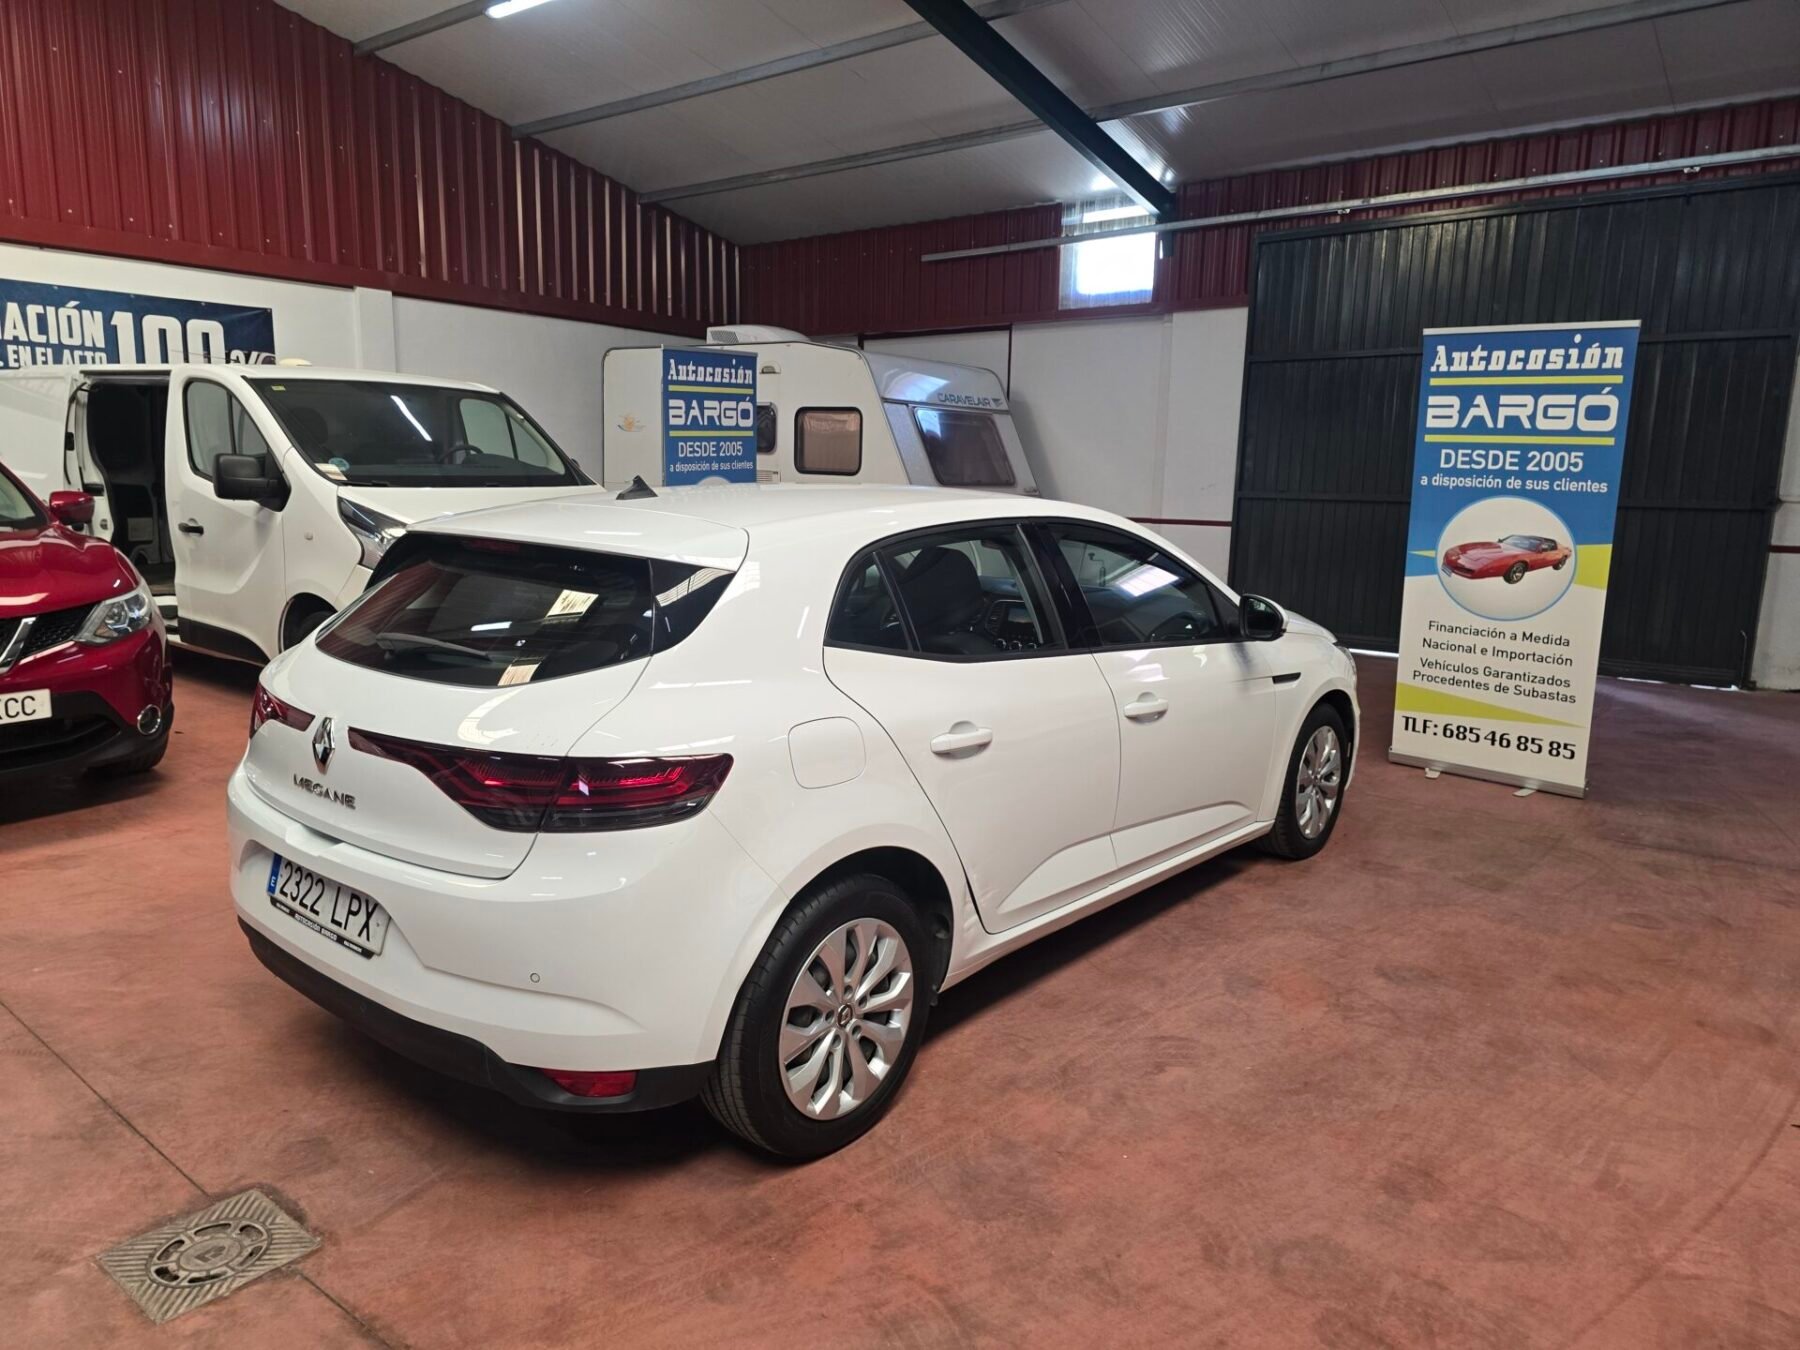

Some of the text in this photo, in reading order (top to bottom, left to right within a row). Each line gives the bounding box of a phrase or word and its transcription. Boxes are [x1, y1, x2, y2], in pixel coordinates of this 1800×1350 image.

[0, 300, 106, 348] ACIÓN
[668, 396, 754, 428] BARGÓ
[1426, 386, 1619, 432] BARGÓ
[678, 441, 743, 458] DESDE 2005
[1439, 449, 1584, 472] DESDE 2005
[669, 460, 754, 474] a disposición de sus clientes
[1420, 473, 1608, 493] a disposición de sus clientes
[1428, 620, 1570, 647] Financiación a Medida
[1422, 637, 1573, 667] Nacional e Importación
[1413, 670, 1577, 704] Procedentes de Subastas
[1420, 657, 1571, 689] Vehículos Garantizados
[0, 695, 37, 719] CC
[1402, 715, 1439, 736] TLF:
[1516, 735, 1544, 754] 85
[1548, 740, 1577, 760] 85
[279, 861, 325, 916] 2322
[330, 886, 379, 942] LPX
